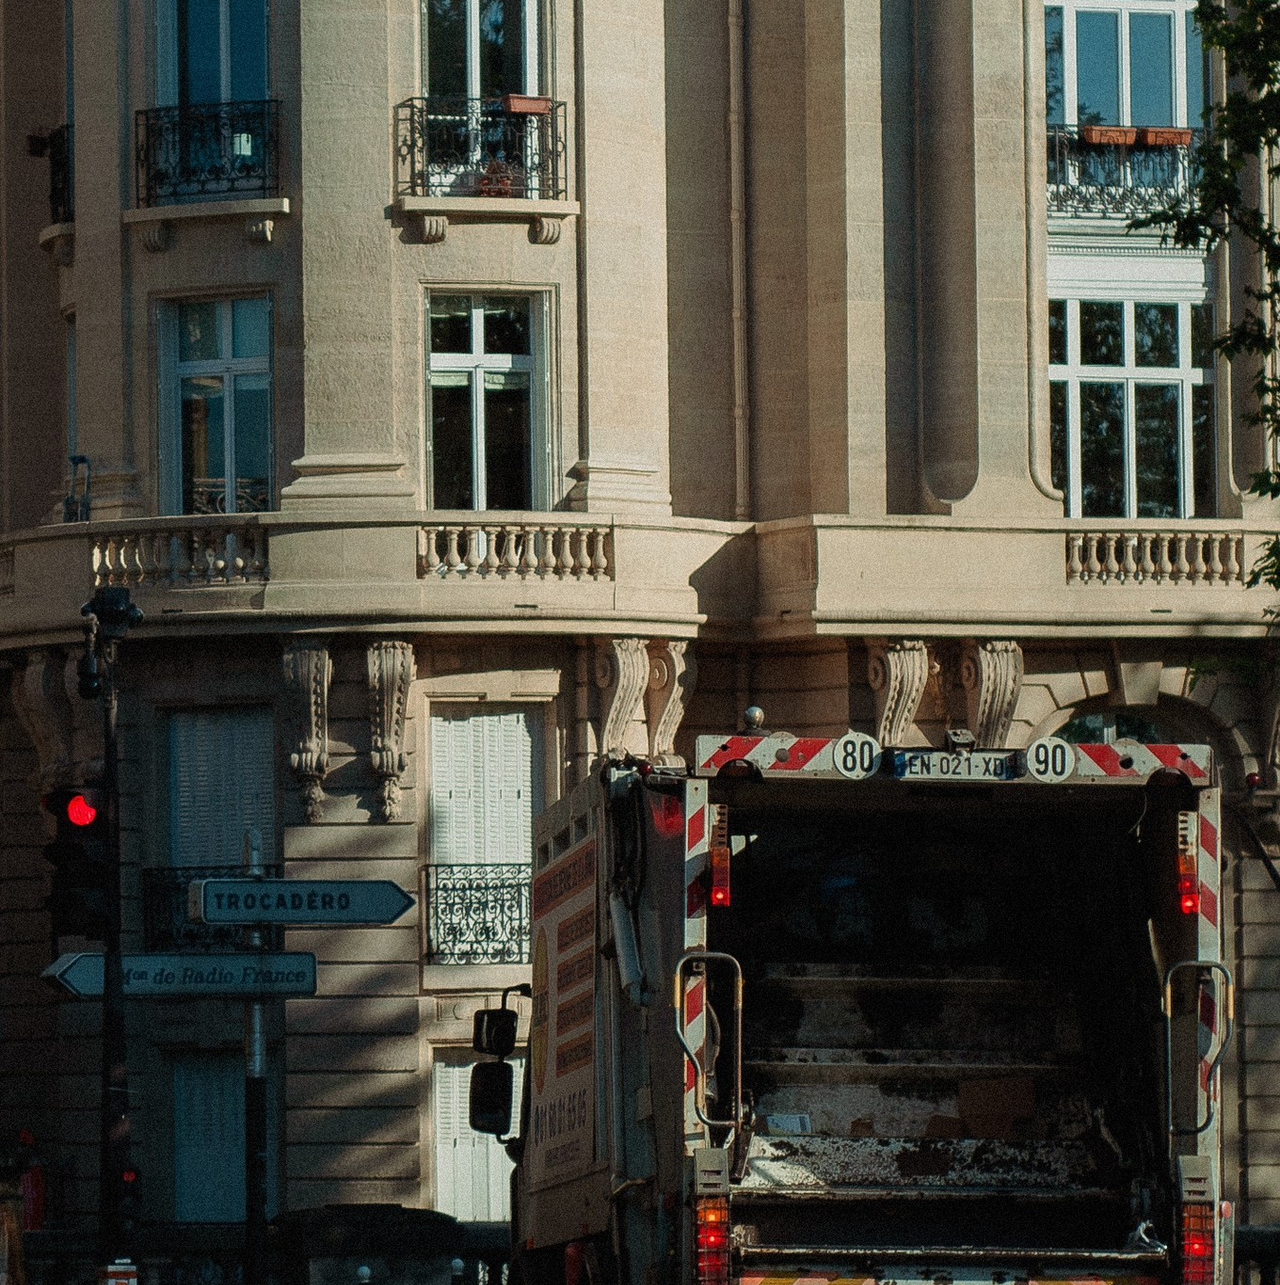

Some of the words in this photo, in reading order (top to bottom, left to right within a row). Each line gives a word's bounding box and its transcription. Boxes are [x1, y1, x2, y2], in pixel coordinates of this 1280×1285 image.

[841, 740, 874, 773] 80
[908, 756, 1004, 776] EN-021-XD
[1034, 744, 1065, 776] 90
[214, 888, 350, 910] TROCADÉRO
[153, 967, 175, 985] de
[182, 967, 234, 985] Radio
[241, 967, 307, 984] France
